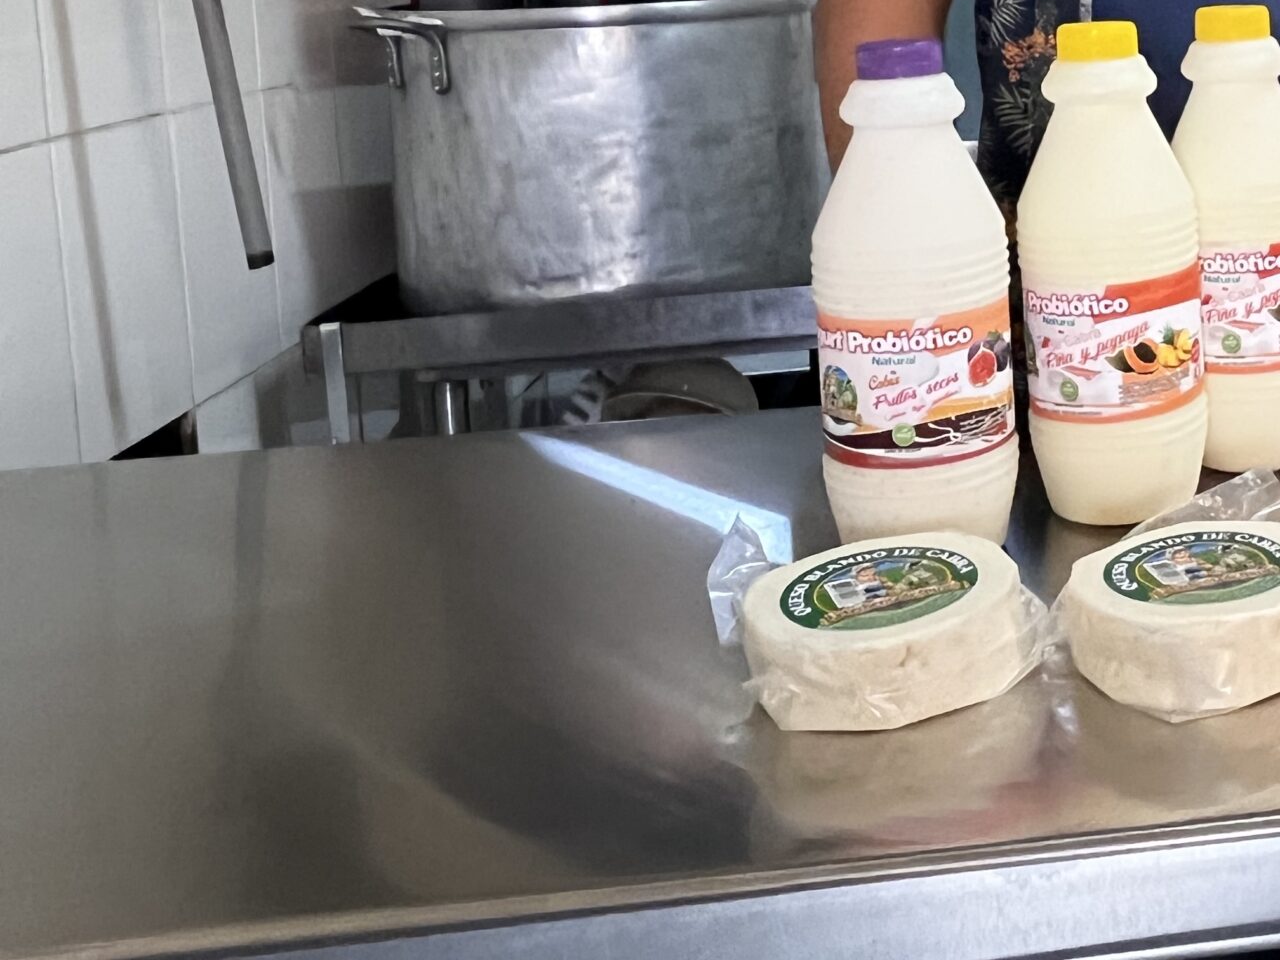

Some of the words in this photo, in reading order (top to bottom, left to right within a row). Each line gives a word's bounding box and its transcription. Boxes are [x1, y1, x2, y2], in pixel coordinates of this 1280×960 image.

[1026, 290, 1130, 317] Probiótico
[847, 324, 973, 355] Probiótico
[1046, 350, 1074, 369] Piña
[1092, 319, 1151, 361] papaya
[872, 355, 917, 366] Natural
[872, 386, 918, 410] Frutas
[926, 372, 960, 395] secas
[1123, 533, 1196, 563] BLANDO
[788, 583, 812, 616] QUESO
[807, 550, 887, 582] BLANDO
[893, 547, 923, 557] DE
